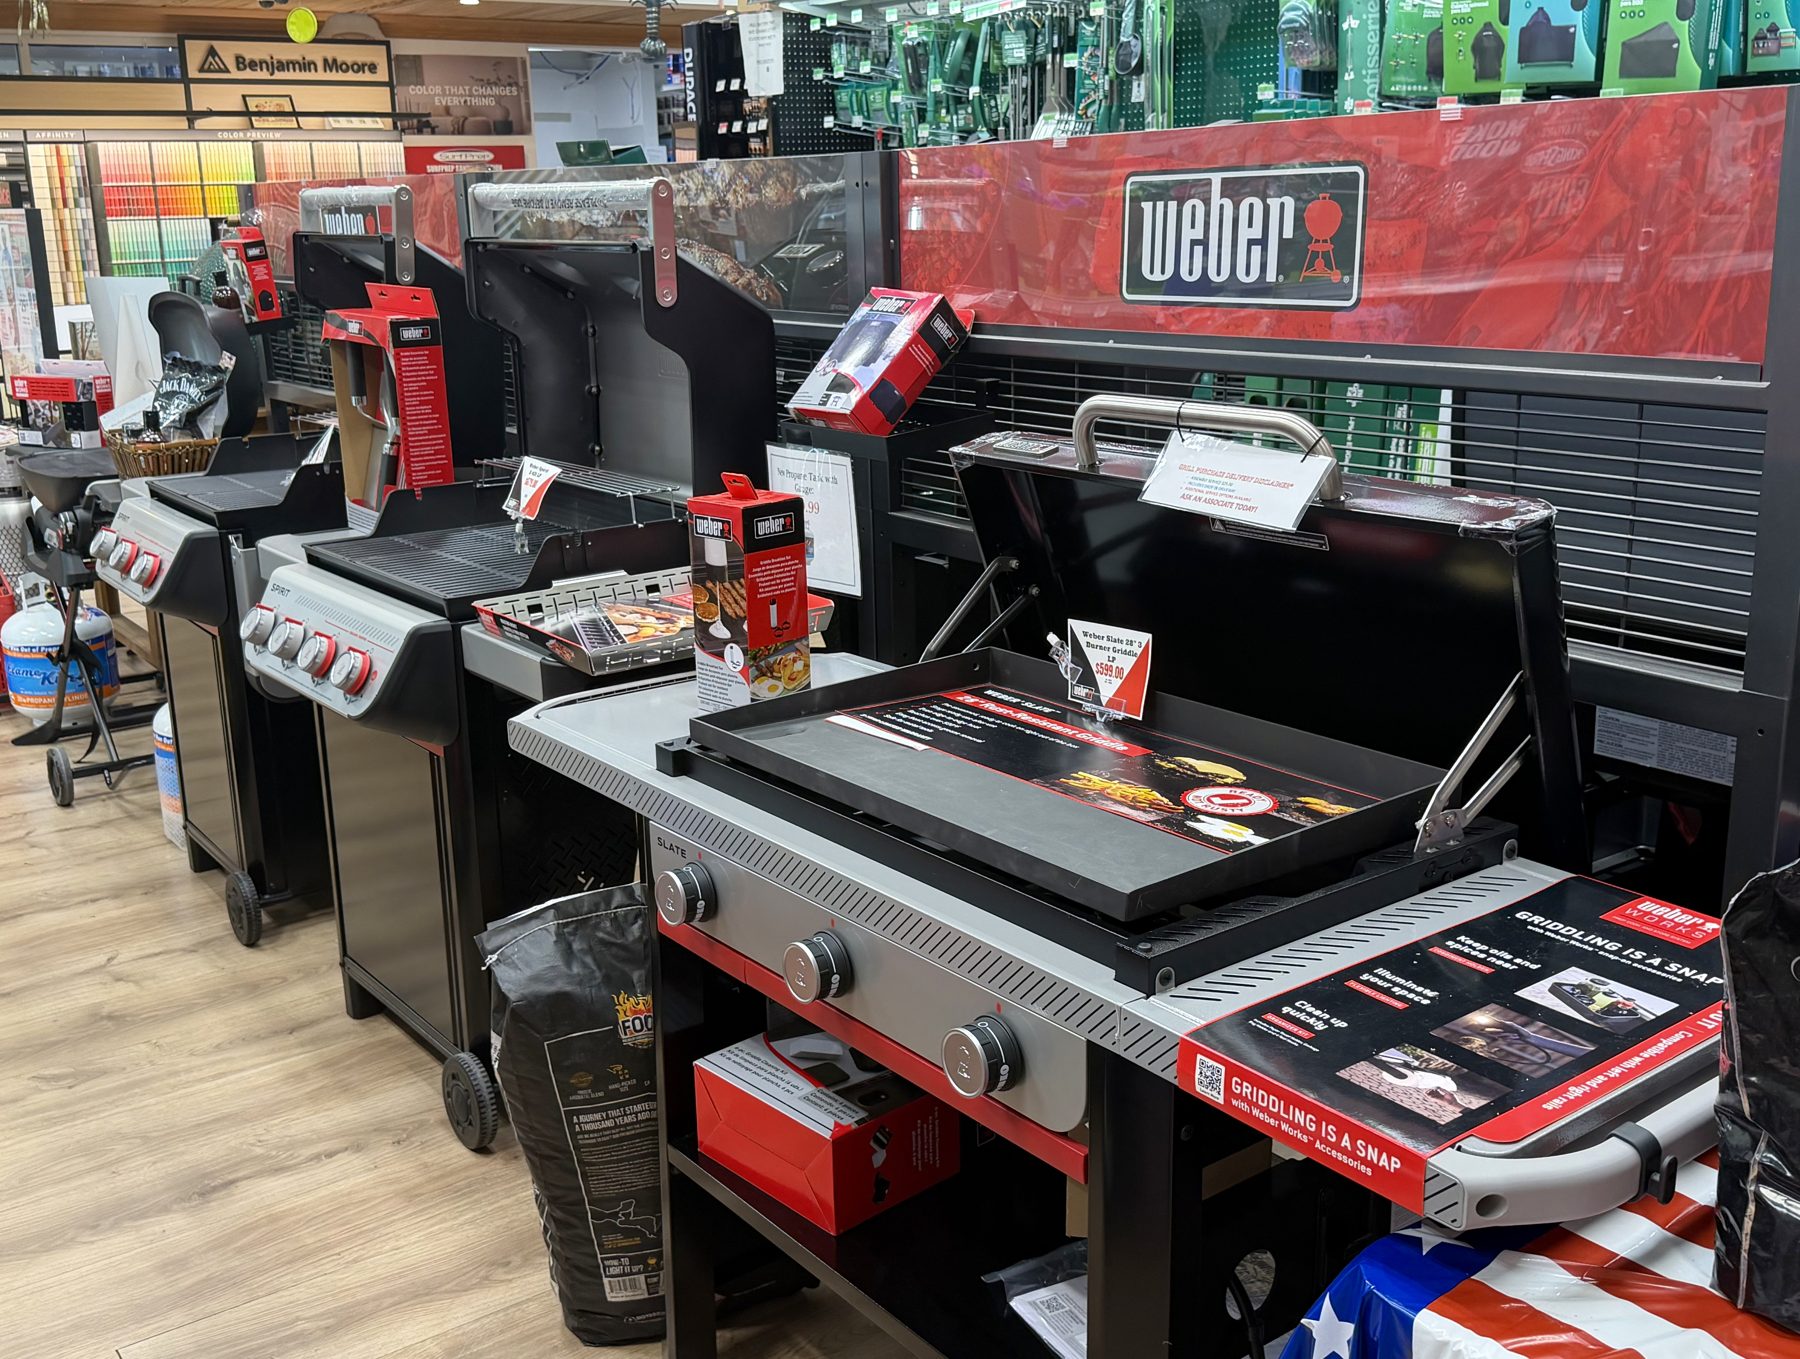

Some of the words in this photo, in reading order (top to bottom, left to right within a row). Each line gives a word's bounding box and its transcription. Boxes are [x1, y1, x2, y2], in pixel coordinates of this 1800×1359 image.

[234, 55, 318, 76] Benjamin
[322, 58, 378, 75] Moore
[408, 85, 442, 95] COLOR
[445, 86, 470, 95] THAT
[472, 86, 518, 96] CHANGES
[434, 96, 496, 106] EVERYTHING
[1141, 178, 1295, 283] weber
[402, 328, 424, 339] weber
[159, 379, 180, 394] JACK
[1180, 492, 1194, 502] ASK
[1193, 495, 1203, 503] AN
[1203, 496, 1235, 509] ASSOCIATE
[1235, 503, 1258, 513] TODAY!
[696, 517, 723, 537] weber
[757, 516, 785, 536] weber
[271, 583, 291, 598] SPIRIT
[1082, 631, 1105, 641] Weber
[1106, 634, 1124, 645] Slate
[1086, 641, 1112, 653] Burner
[1112, 645, 1138, 658] Griddle
[1107, 655, 1116, 663] LP
[1095, 662, 1125, 680] $599.00
[980, 701, 1079, 736] Rust-Resistant
[1076, 732, 1130, 751] Griddle
[657, 837, 687, 859] SLATE
[1624, 907, 1708, 939] WORKS
[1636, 900, 1705, 926] weber
[1445, 940, 1488, 959] spices
[1486, 957, 1518, 970] near
[1456, 935, 1489, 951] Keep
[1488, 948, 1514, 960] oils
[1513, 957, 1541, 970] and
[1514, 911, 1623, 952] GRIDDLING
[1622, 947, 1647, 960] IS
[1644, 957, 1661, 967] A
[1664, 963, 1725, 986] SNAP
[1527, 925, 1545, 937] with
[1544, 931, 1570, 944] Weber
[1598, 950, 1632, 966] snap-on
[1632, 961, 1683, 983] accessories
[1359, 973, 1393, 988] your
[1390, 986, 1431, 1005] space
[1373, 967, 1439, 997] Illuminate
[1281, 1006, 1329, 1031] quickly
[1294, 1000, 1331, 1019] Clean
[1330, 1017, 1348, 1028] up
[1266, 1014, 1300, 1032] ORGANIZER
[1298, 1029, 1309, 1037] KIT
[1649, 1030, 1694, 1058] Compatible
[731, 1059, 751, 1074] nettoyage
[750, 1070, 763, 1079] pour
[740, 1056, 757, 1068] limpieza
[756, 1064, 768, 1073] para
[767, 1069, 786, 1083] plancha
[745, 1051, 762, 1063] Griddle
[760, 1058, 780, 1072] Cleaning
[1605, 1062, 1626, 1080] left
[1619, 1051, 1645, 1070] with
[1567, 1080, 1592, 1100] right
[1586, 1073, 1609, 1089] and
[1541, 1093, 1569, 1111] rails
[573, 1115, 579, 1124] A
[579, 1111, 607, 1123] JOURNEY
[607, 1108, 625, 1118] THAT
[575, 1124, 581, 1132] A
[580, 1119, 615, 1131] THOUSAND
[615, 1114, 637, 1126] YEARS
[637, 1110, 651, 1121] AGO
[1231, 1077, 1317, 1132] GRIDDLING
[1321, 1121, 1337, 1143] IS
[1340, 1133, 1352, 1151] A
[1356, 1139, 1402, 1174] SNAP
[1231, 1097, 1251, 1114] with
[1250, 1106, 1280, 1129] Weber
[1314, 1139, 1373, 1176] Accessories
[604, 1257, 630, 1266] HOW-TO
[606, 1266, 625, 1275] LIGHT
[624, 1265, 631, 1273] IT
